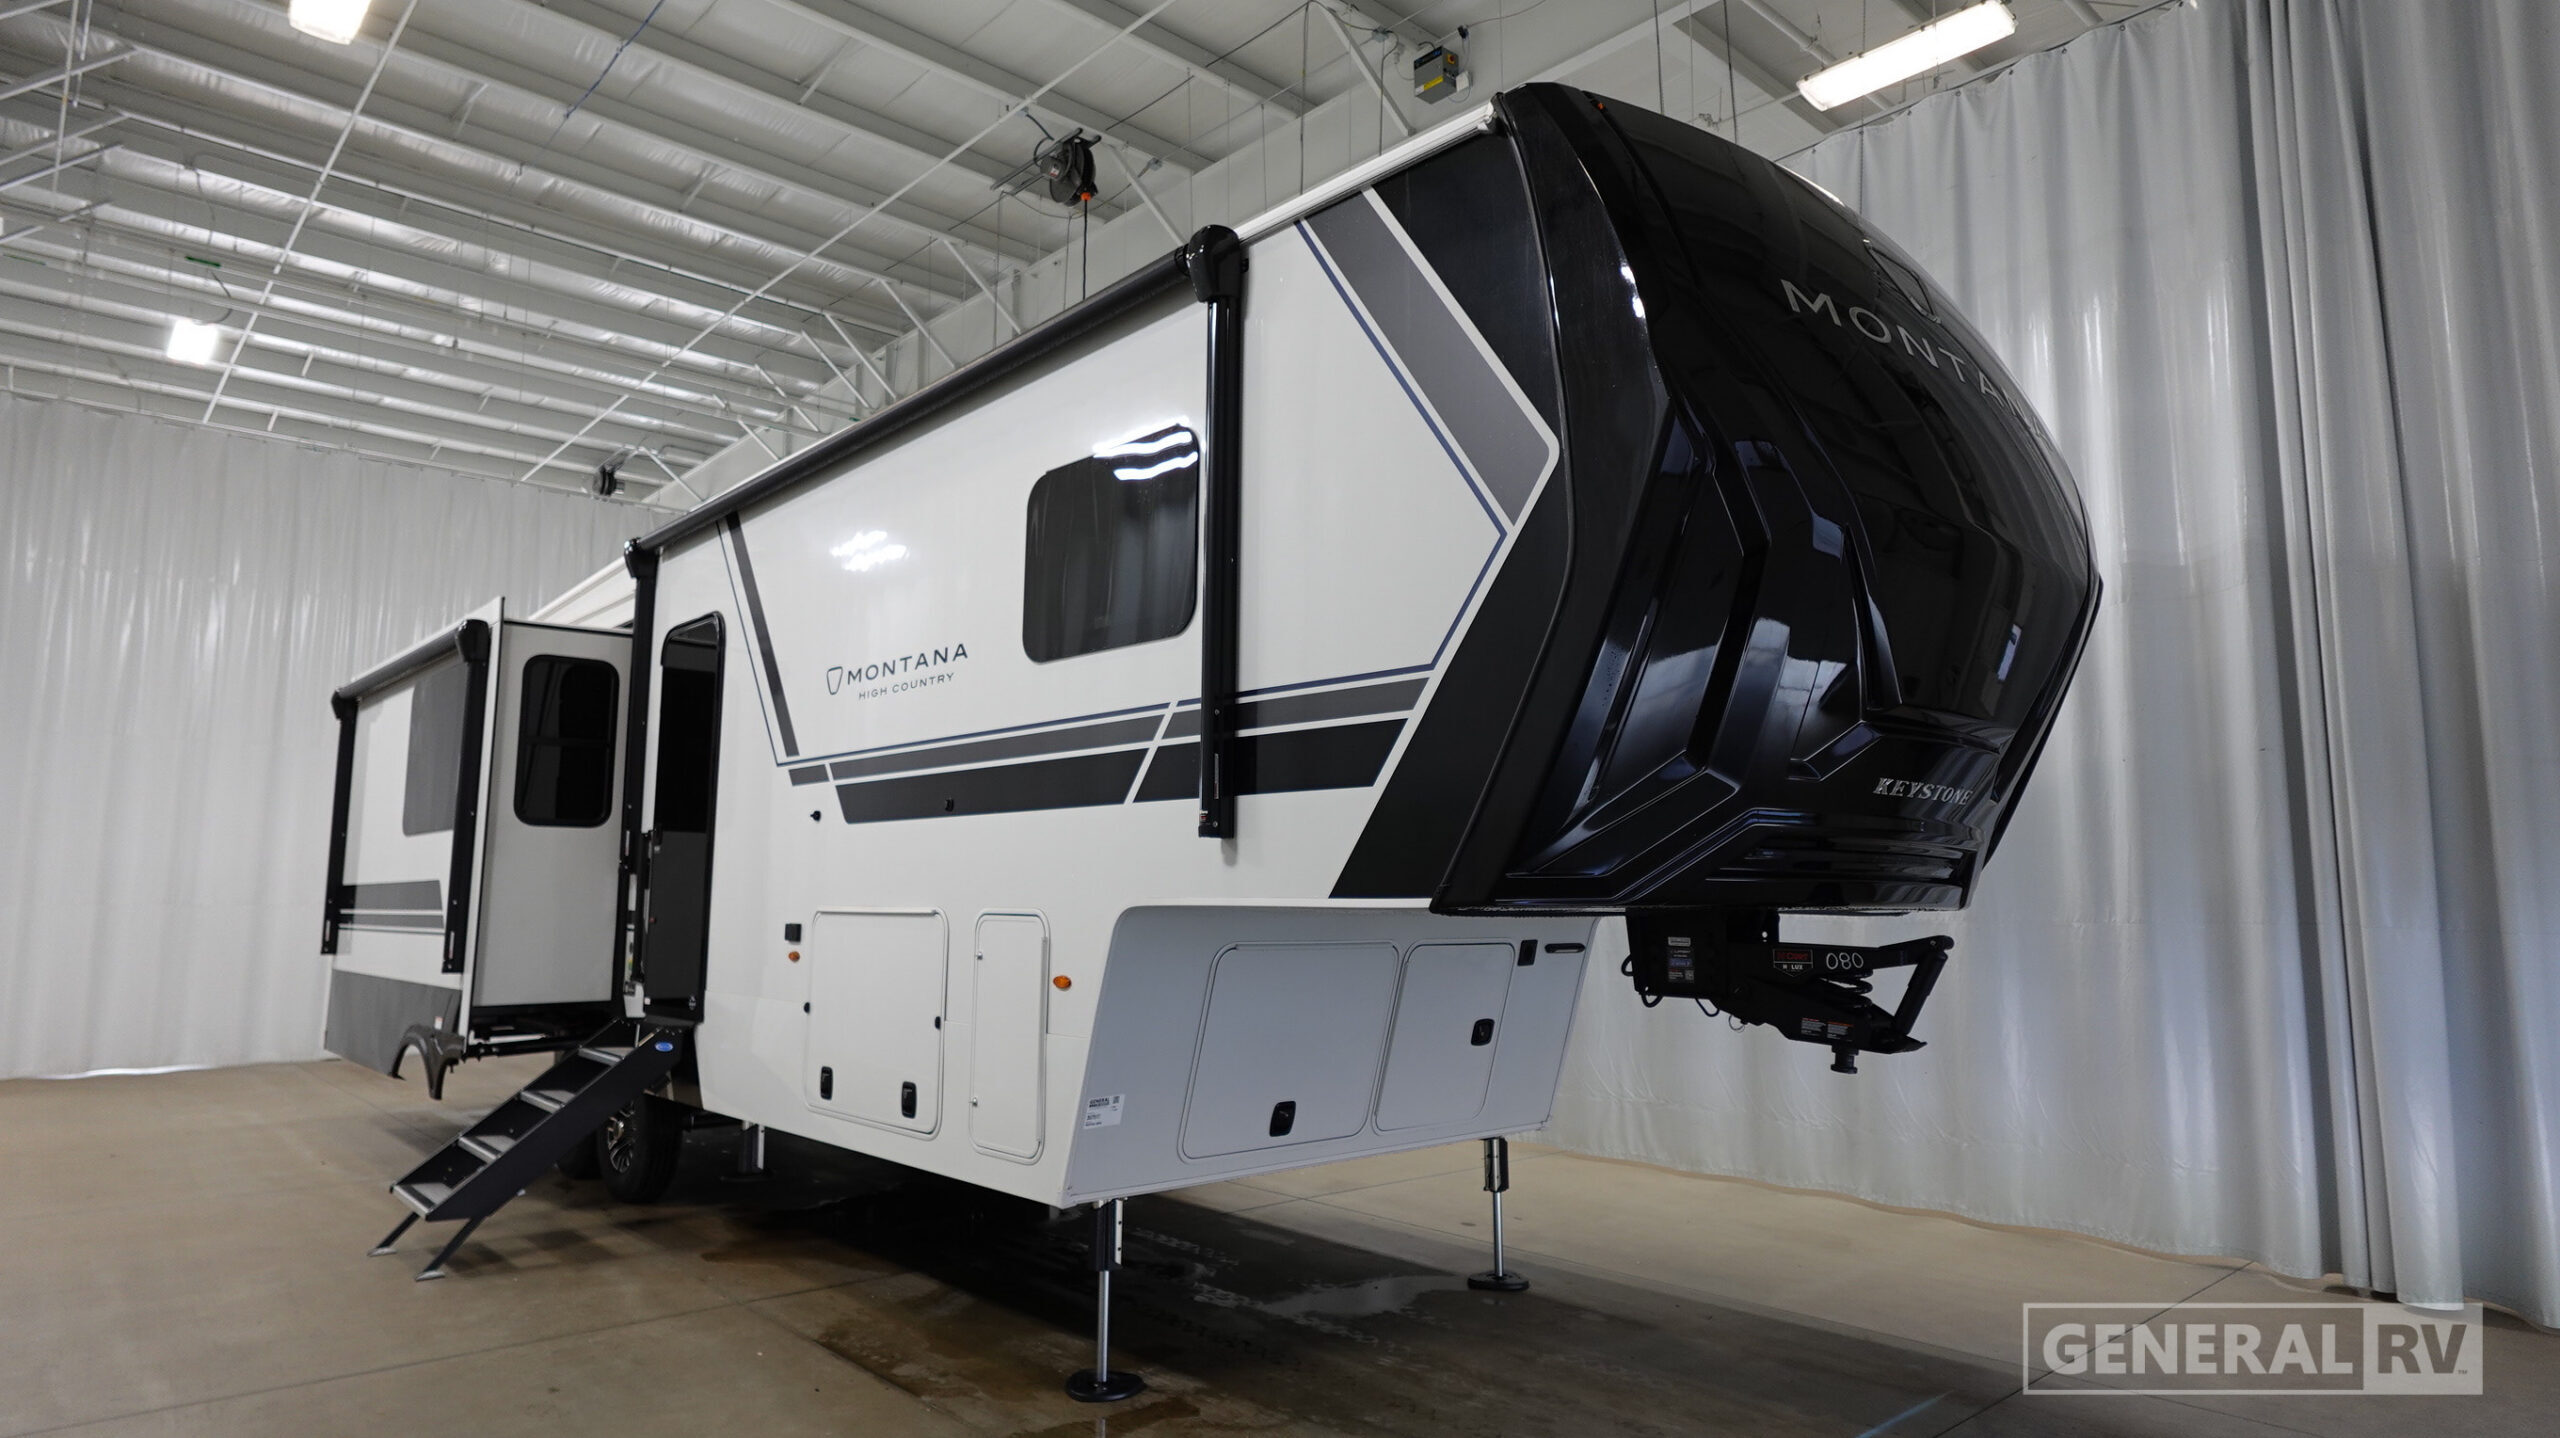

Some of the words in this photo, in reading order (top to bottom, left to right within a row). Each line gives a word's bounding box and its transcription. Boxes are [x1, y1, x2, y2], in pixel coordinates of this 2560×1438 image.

[847, 643, 968, 685] MONTANA
[858, 687, 888, 700] HIGH
[892, 672, 955, 693] COUNTRY
[1873, 777, 1974, 806] KEYSTONE
[1825, 952, 1865, 970] 080
